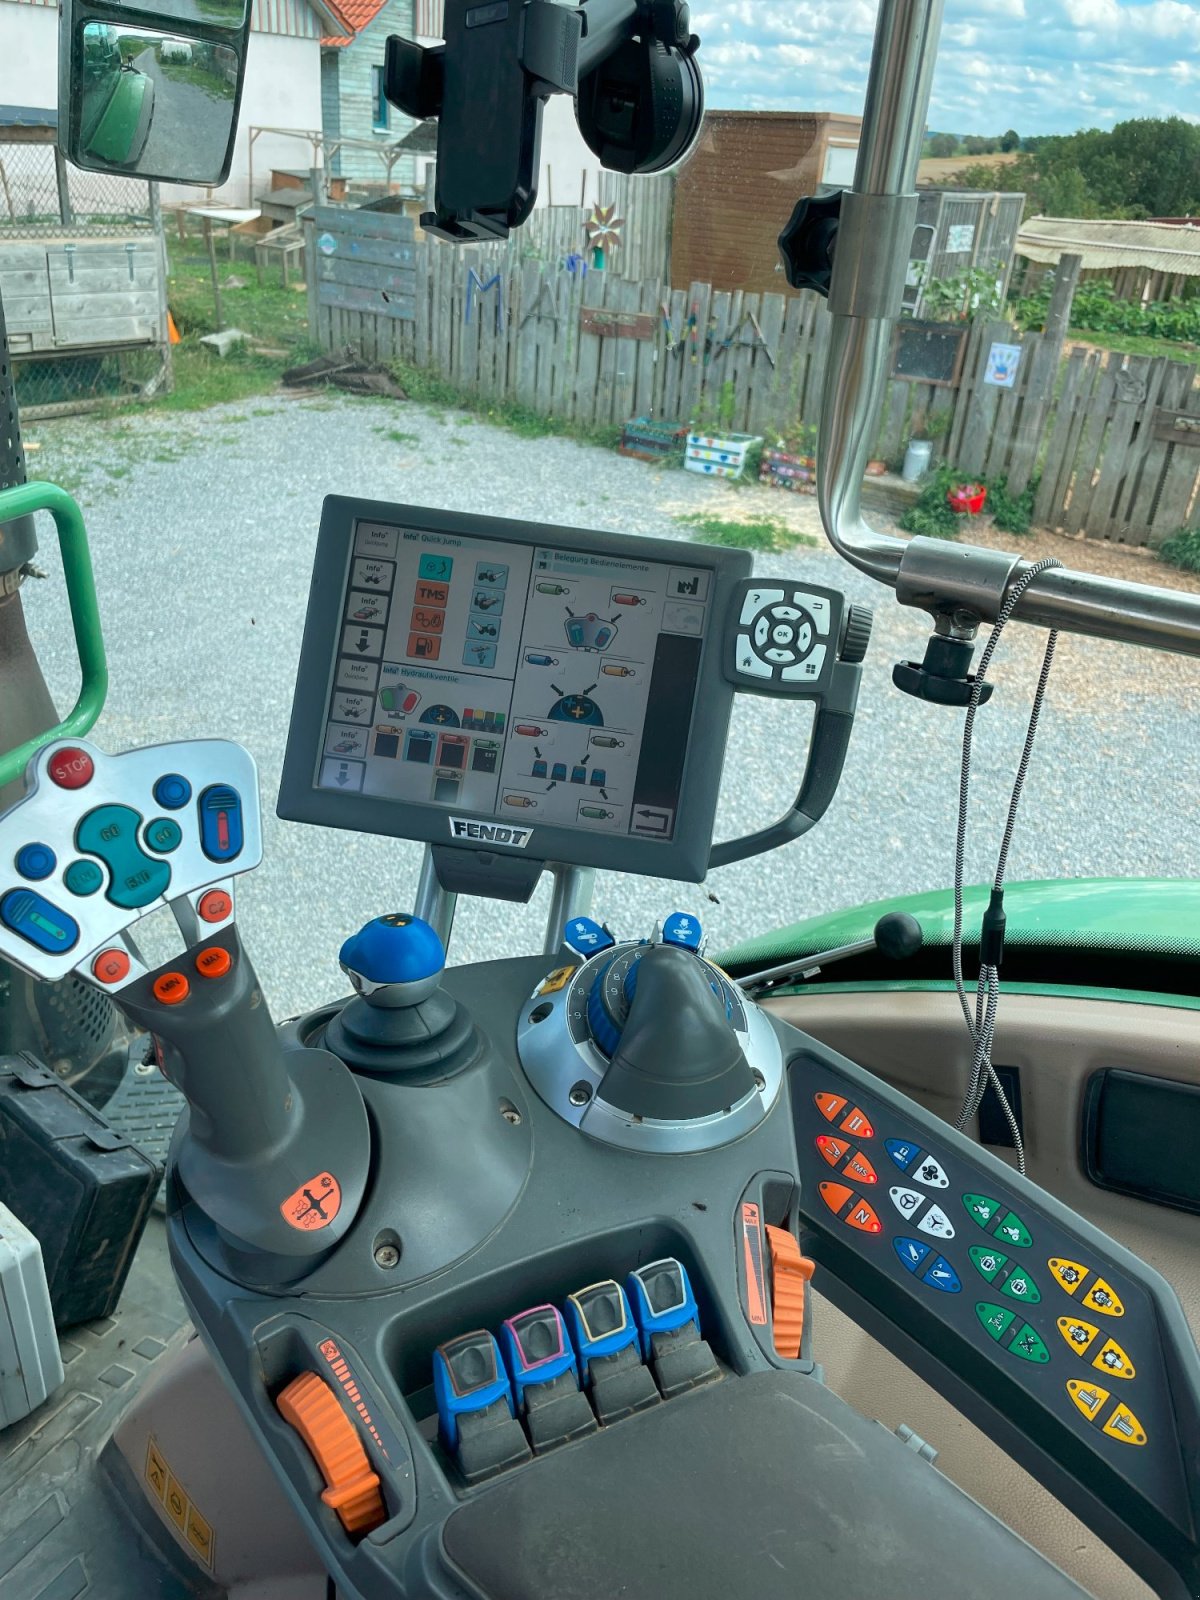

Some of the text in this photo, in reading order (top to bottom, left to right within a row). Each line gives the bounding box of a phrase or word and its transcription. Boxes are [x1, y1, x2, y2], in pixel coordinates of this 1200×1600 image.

[554, 553, 649, 572] Belegung Bedienelemente
[419, 588, 445, 601] TMS
[777, 630, 788, 639] OK
[400, 668, 459, 683] Hydraulikventile
[56, 755, 89, 779] STOP
[453, 821, 527, 844] FENDT
[208, 900, 226, 915] C2
[201, 952, 222, 968] MAX
[622, 960, 629, 969] 7
[105, 961, 121, 976] C1
[592, 968, 599, 976] 7
[613, 972, 621, 981] 8
[159, 977, 181, 994] MIN
[578, 987, 585, 996] 8
[610, 987, 618, 996] 9
[575, 1011, 582, 1020] 9
[850, 1160, 868, 1177] TMS
[855, 1209, 870, 1224] N
[1073, 1328, 1082, 1338] 540
